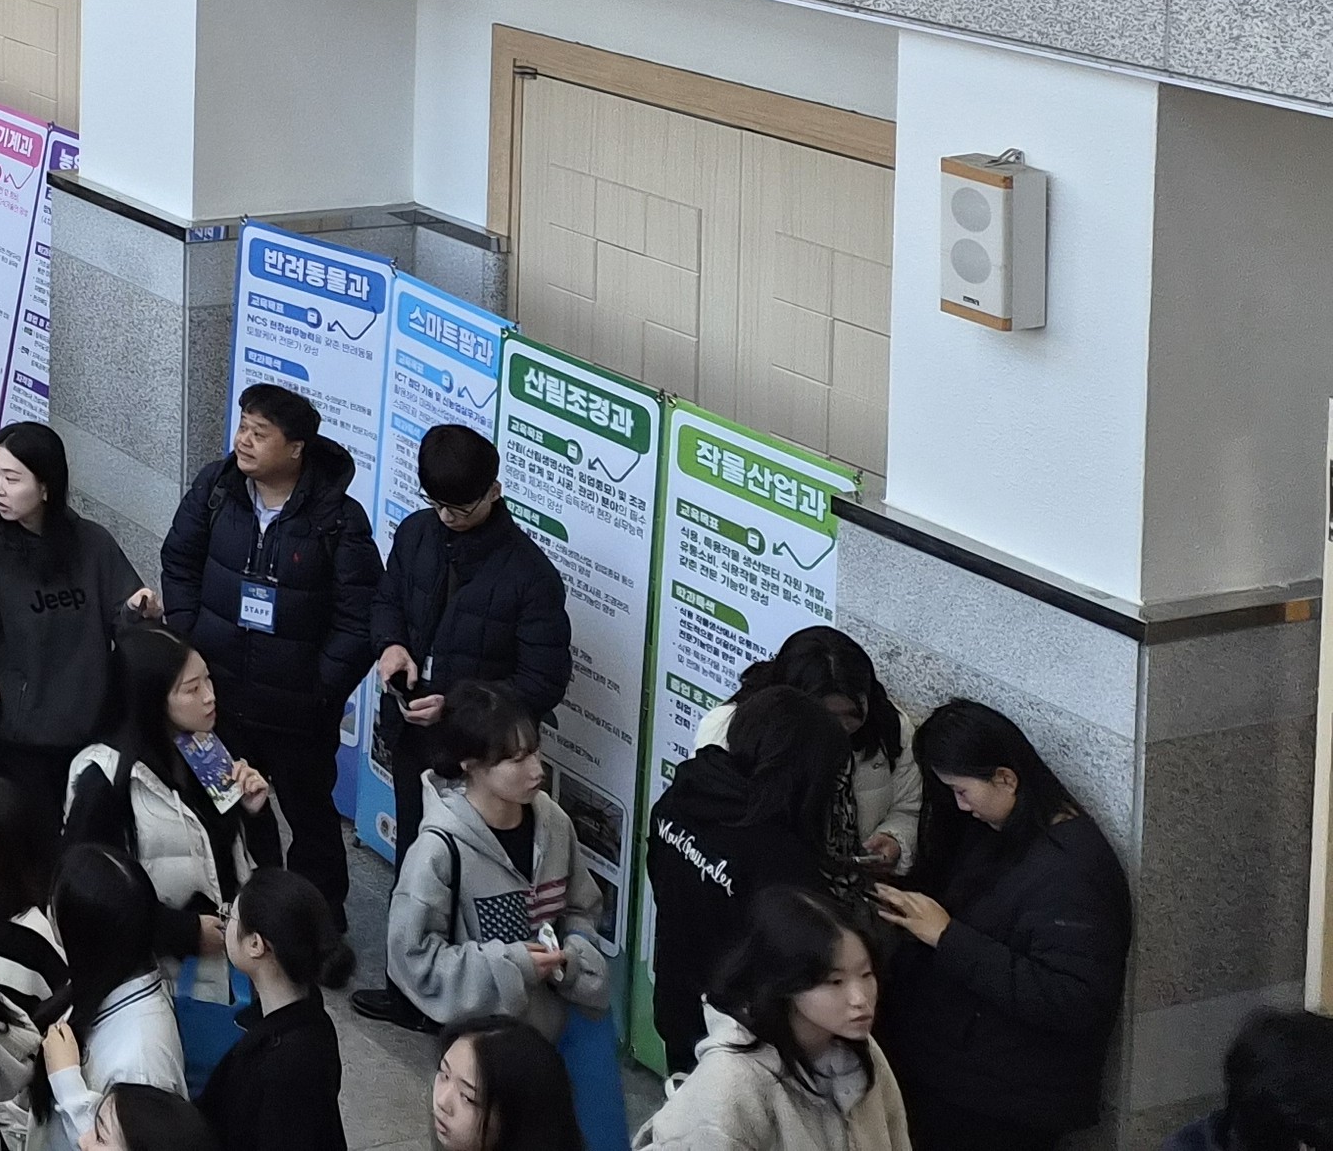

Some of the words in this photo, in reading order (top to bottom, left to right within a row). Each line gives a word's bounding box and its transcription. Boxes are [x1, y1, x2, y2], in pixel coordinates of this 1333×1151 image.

[263, 247, 370, 302] 반려동물과
[246, 313, 269, 327] NCS
[408, 304, 494, 368] 스마트팜과
[394, 369, 408, 385] ICT
[523, 366, 635, 438] 산림조경과
[527, 462, 545, 476] 설계
[695, 436, 827, 524] 작물산업과
[628, 493, 647, 513] 조경
[679, 502, 720, 532] 교육목표
[680, 525, 702, 544] 식용,
[703, 536, 740, 562] 특용작물
[742, 554, 781, 581] 생산부터
[782, 572, 803, 592] 자원
[804, 582, 828, 605] 개발,
[721, 559, 759, 586] 식용작물
[760, 578, 780, 597] 관련
[30, 587, 87, 614] Jeep
[699, 566, 718, 583] 전문
[719, 571, 749, 596] 기능인
[749, 587, 770, 607] 양성
[244, 605, 270, 617] STAFF
